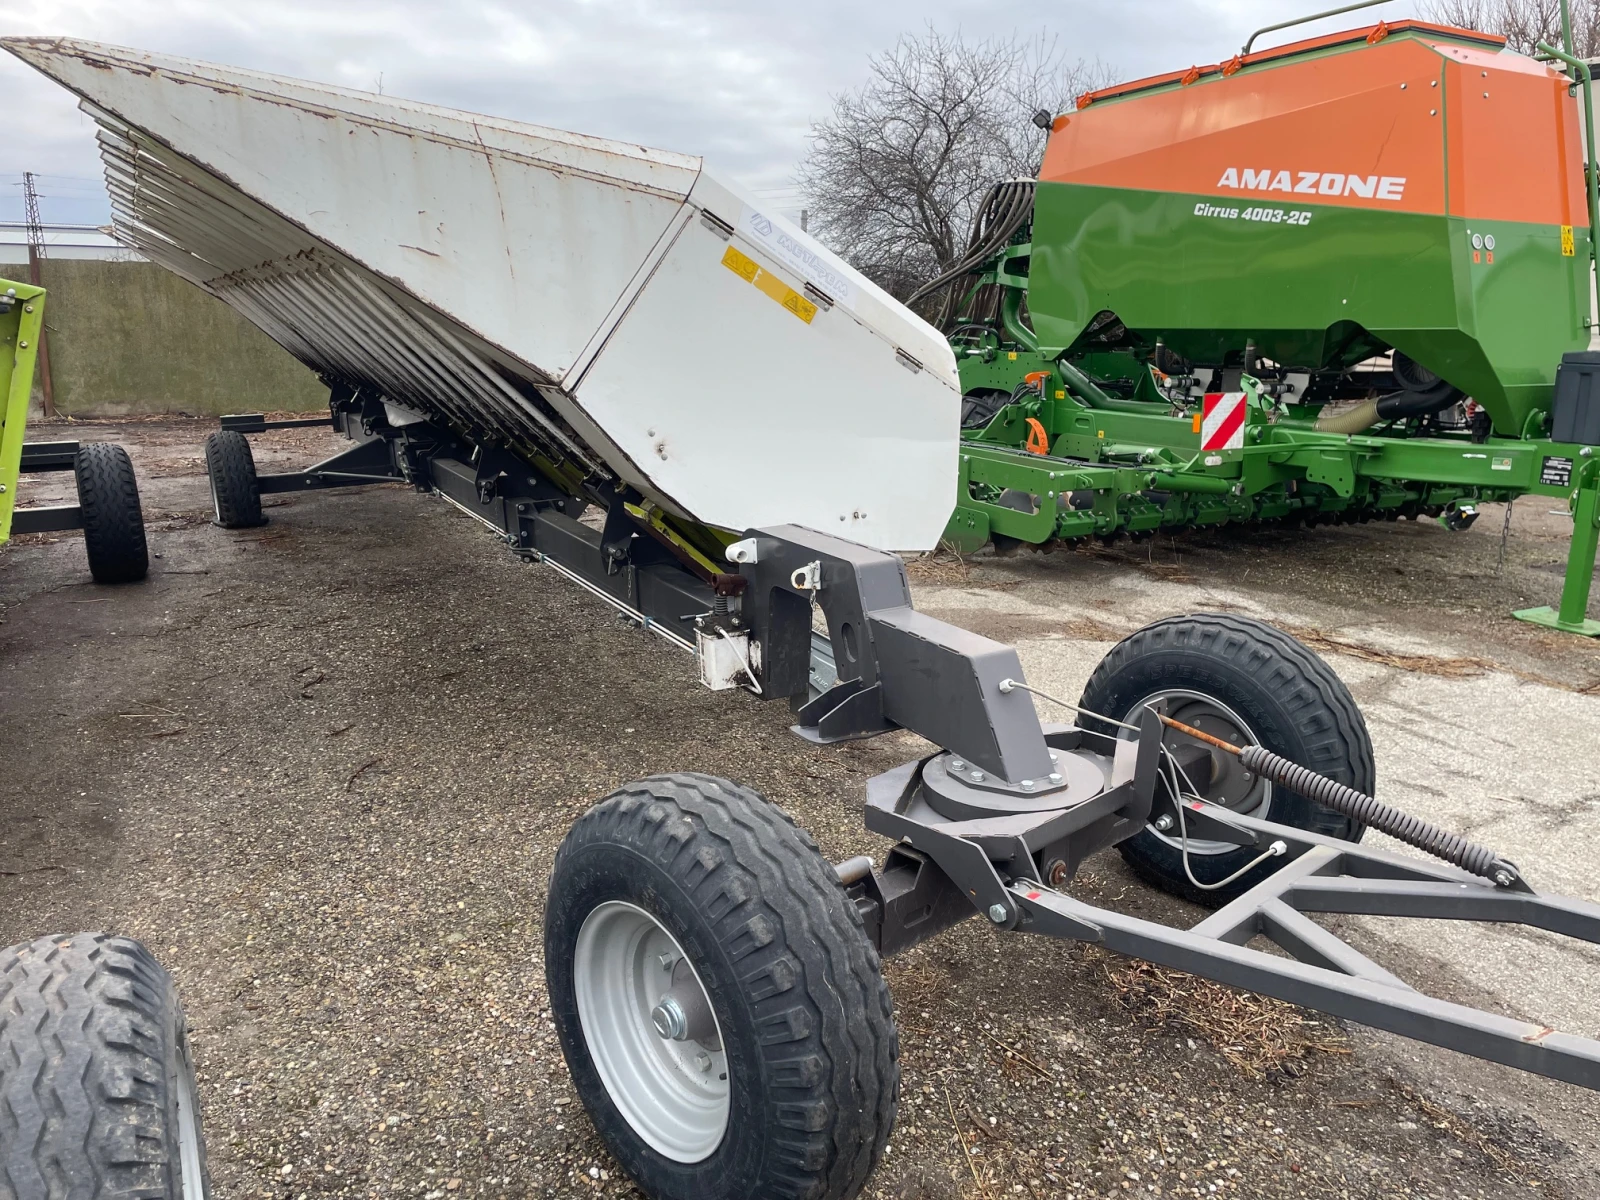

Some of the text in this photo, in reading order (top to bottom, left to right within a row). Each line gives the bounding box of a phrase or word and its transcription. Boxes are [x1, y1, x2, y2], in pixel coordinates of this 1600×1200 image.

[1217, 168, 1406, 200] AMAZONE
[1194, 203, 1312, 225] Cirrus 4003-2C
[1149, 664, 1286, 750] SPEEDWAYS
